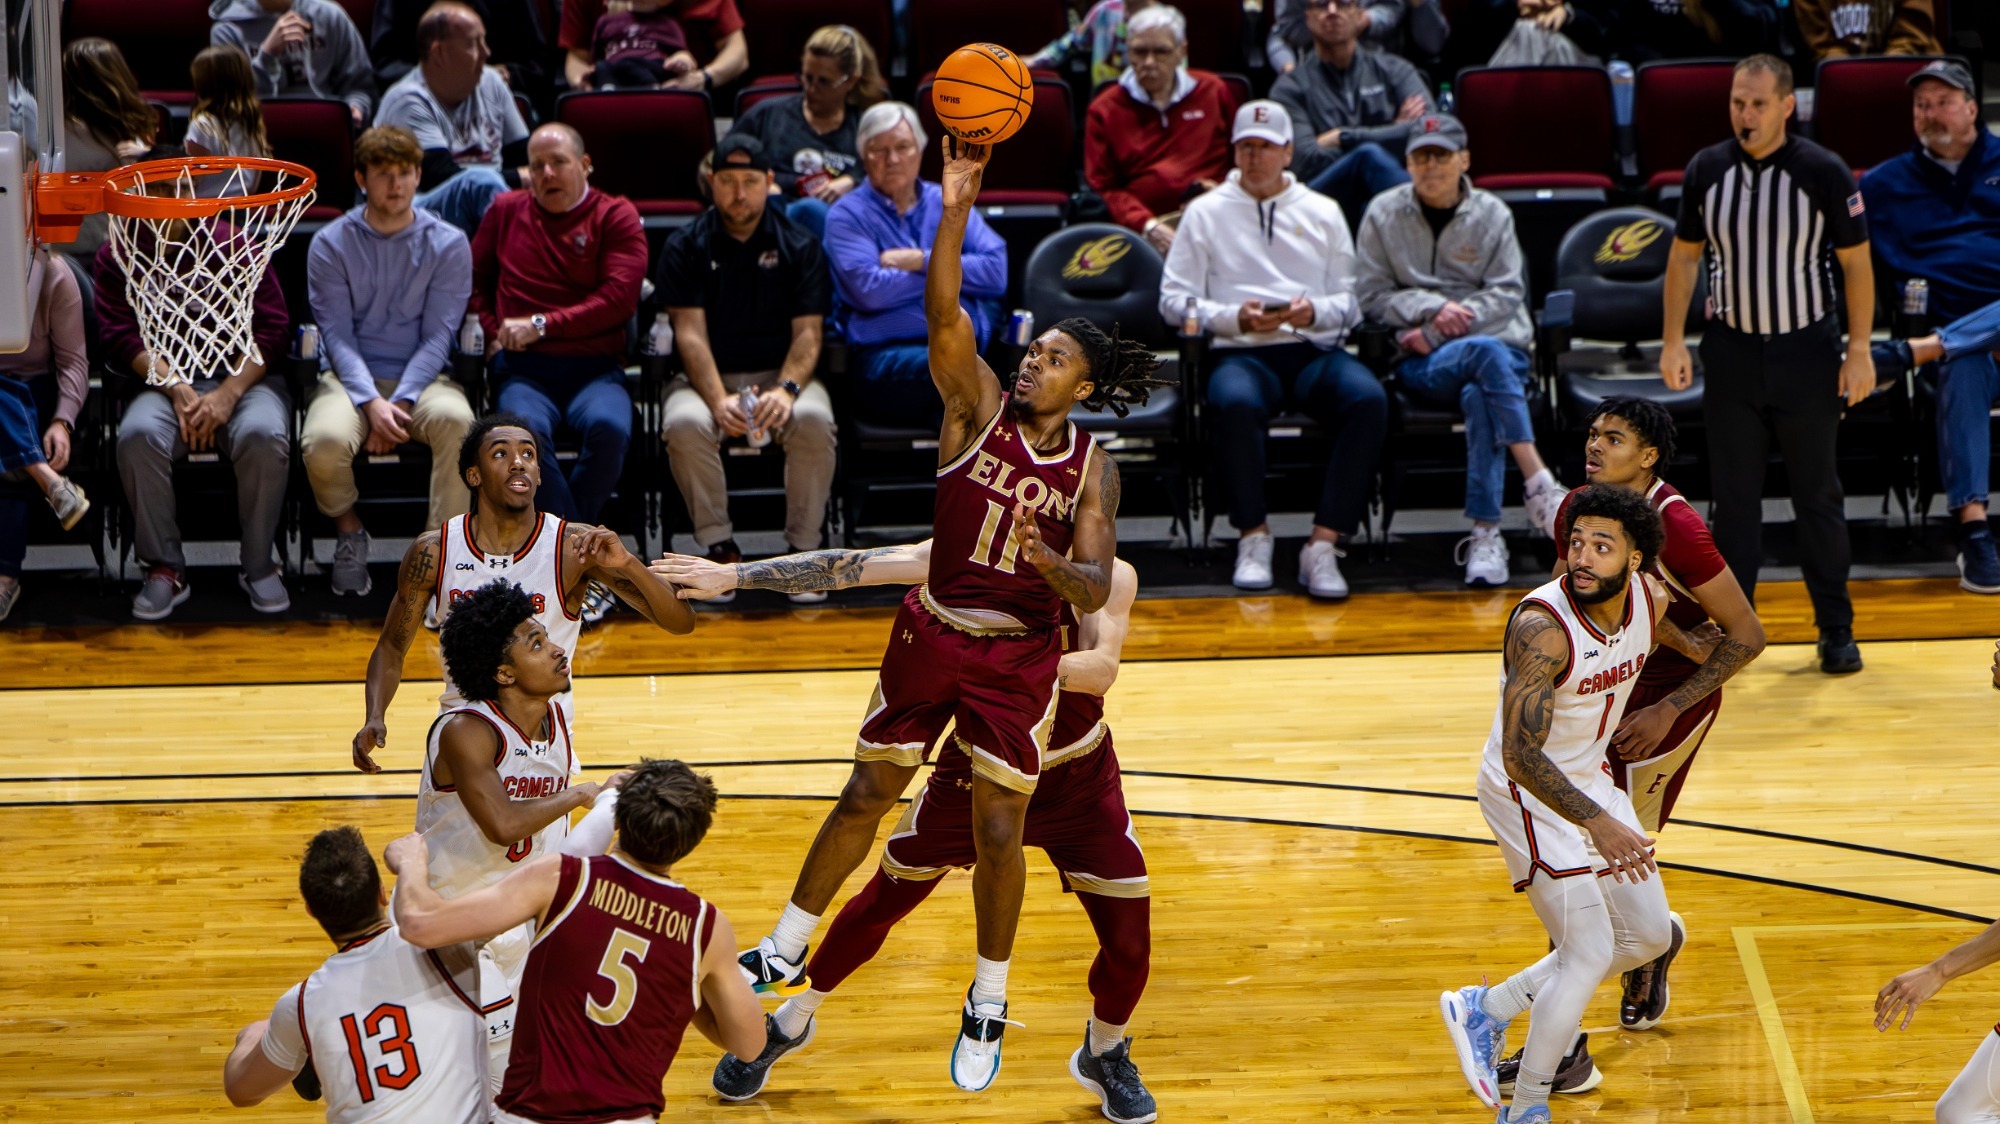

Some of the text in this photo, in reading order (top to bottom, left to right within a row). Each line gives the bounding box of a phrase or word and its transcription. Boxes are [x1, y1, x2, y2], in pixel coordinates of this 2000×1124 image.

[1253, 107, 1271, 124] E
[966, 449, 1075, 523] ELON
[968, 498, 1027, 575] 11
[455, 563, 475, 571] CAA
[1583, 649, 1599, 660] CAA
[1593, 692, 1615, 745] 1
[514, 748, 528, 757] CAA
[1645, 772, 1668, 795] E
[588, 878, 692, 945] MIDDLETON
[585, 927, 652, 1027] 5
[339, 1002, 422, 1104] 13
